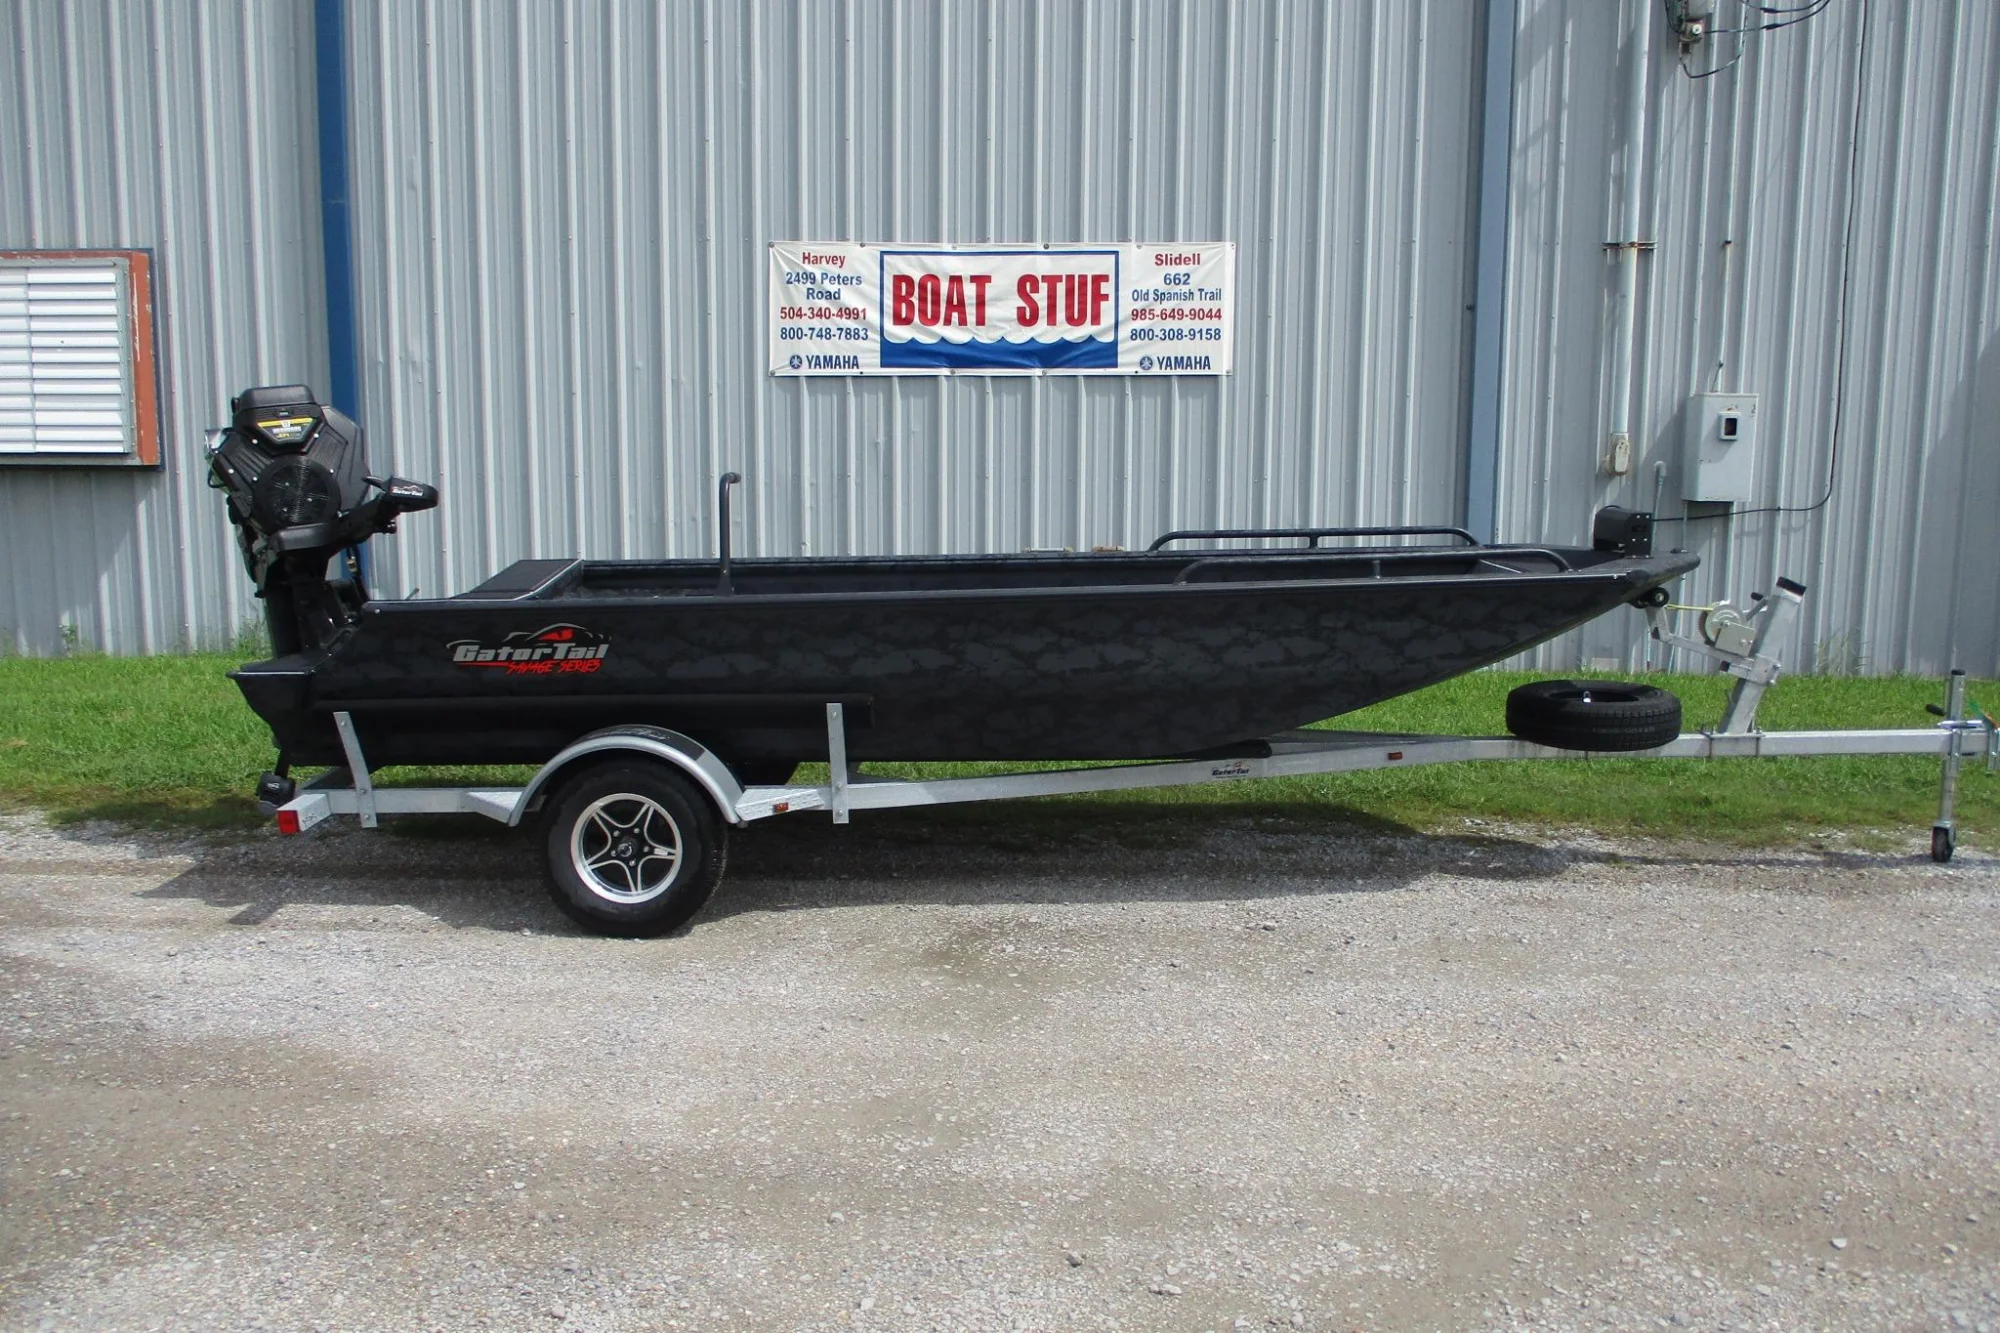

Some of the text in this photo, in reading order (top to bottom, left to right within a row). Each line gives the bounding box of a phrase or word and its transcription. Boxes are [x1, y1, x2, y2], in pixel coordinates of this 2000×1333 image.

[802, 252, 846, 268] Harvey
[1154, 253, 1201, 266] Slidell
[785, 271, 863, 286] 2499 Peters
[1163, 272, 1191, 286] 662
[805, 287, 841, 301] Road
[891, 273, 1110, 328] BOAT STUF
[1131, 288, 1222, 305] Old Spanish Trail
[779, 306, 867, 321] 504-340-4991
[1130, 307, 1223, 321] 985-649-9044
[780, 327, 869, 341] 800-748-7883
[1130, 328, 1222, 341] 800-308-9158
[806, 355, 860, 370] YAMAHA
[1156, 355, 1212, 371] YAMAHA
[452, 642, 610, 662] GatorTail
[505, 659, 602, 676] SAVAGE SERIES
